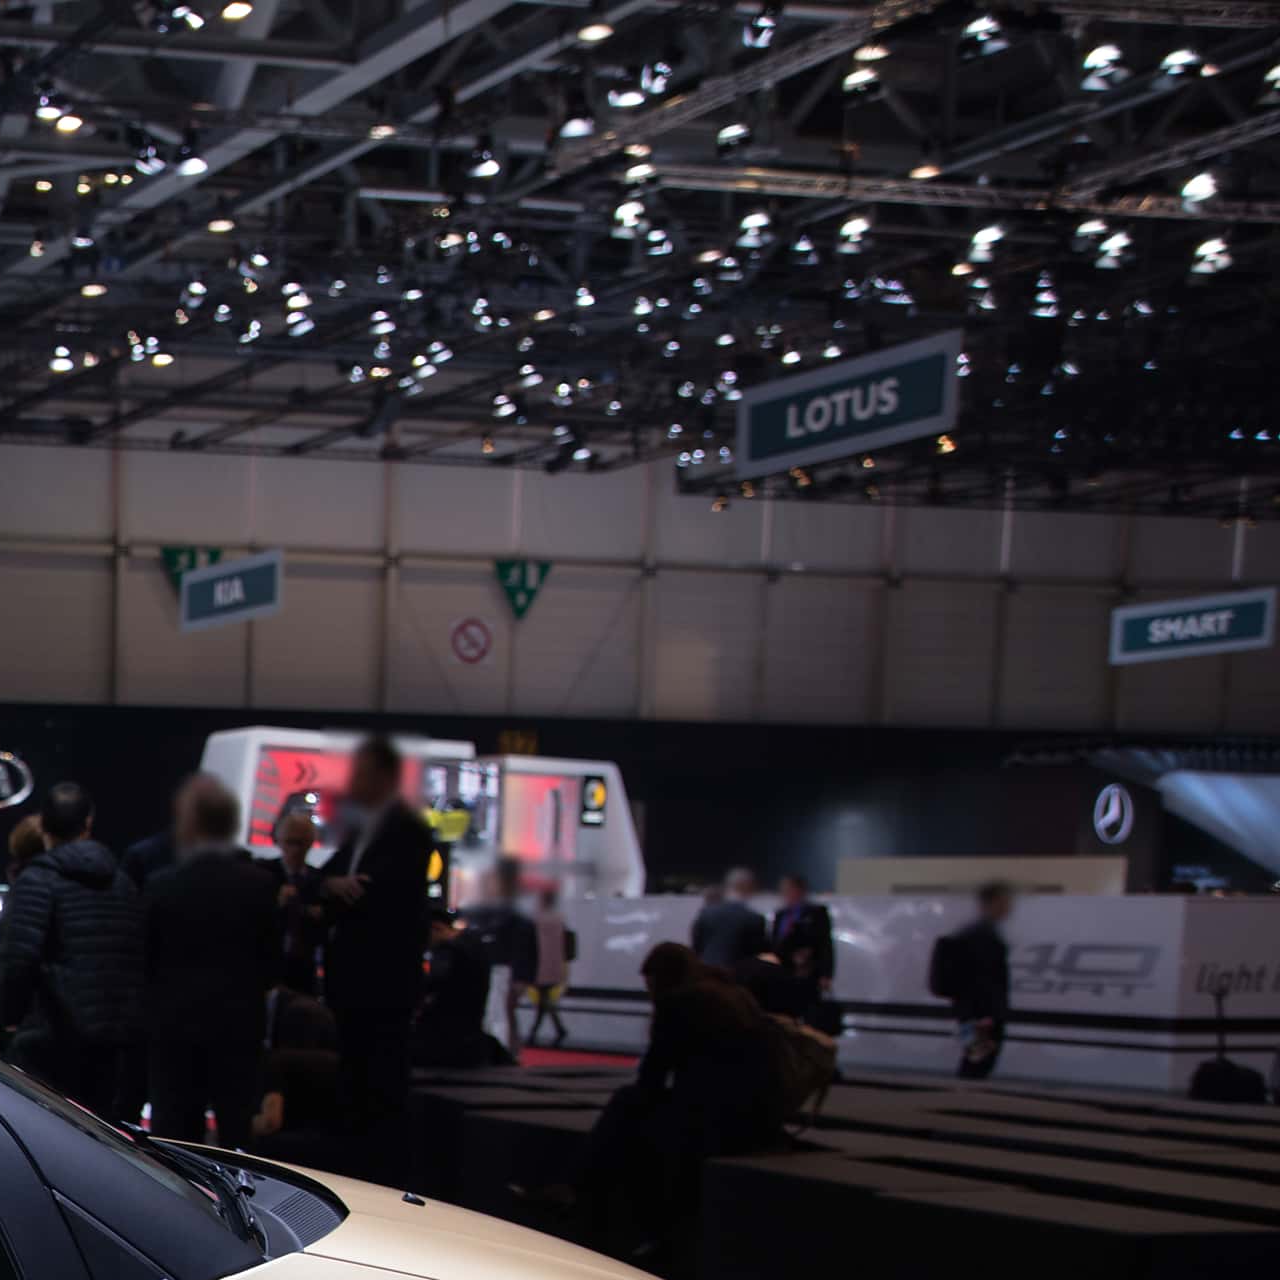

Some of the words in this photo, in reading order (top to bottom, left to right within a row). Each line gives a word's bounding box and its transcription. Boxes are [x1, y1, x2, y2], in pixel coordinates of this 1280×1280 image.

[784, 376, 900, 439] LOTUS
[213, 575, 246, 609] KIA
[1147, 609, 1235, 644] SMART
[1196, 963, 1266, 996] light
